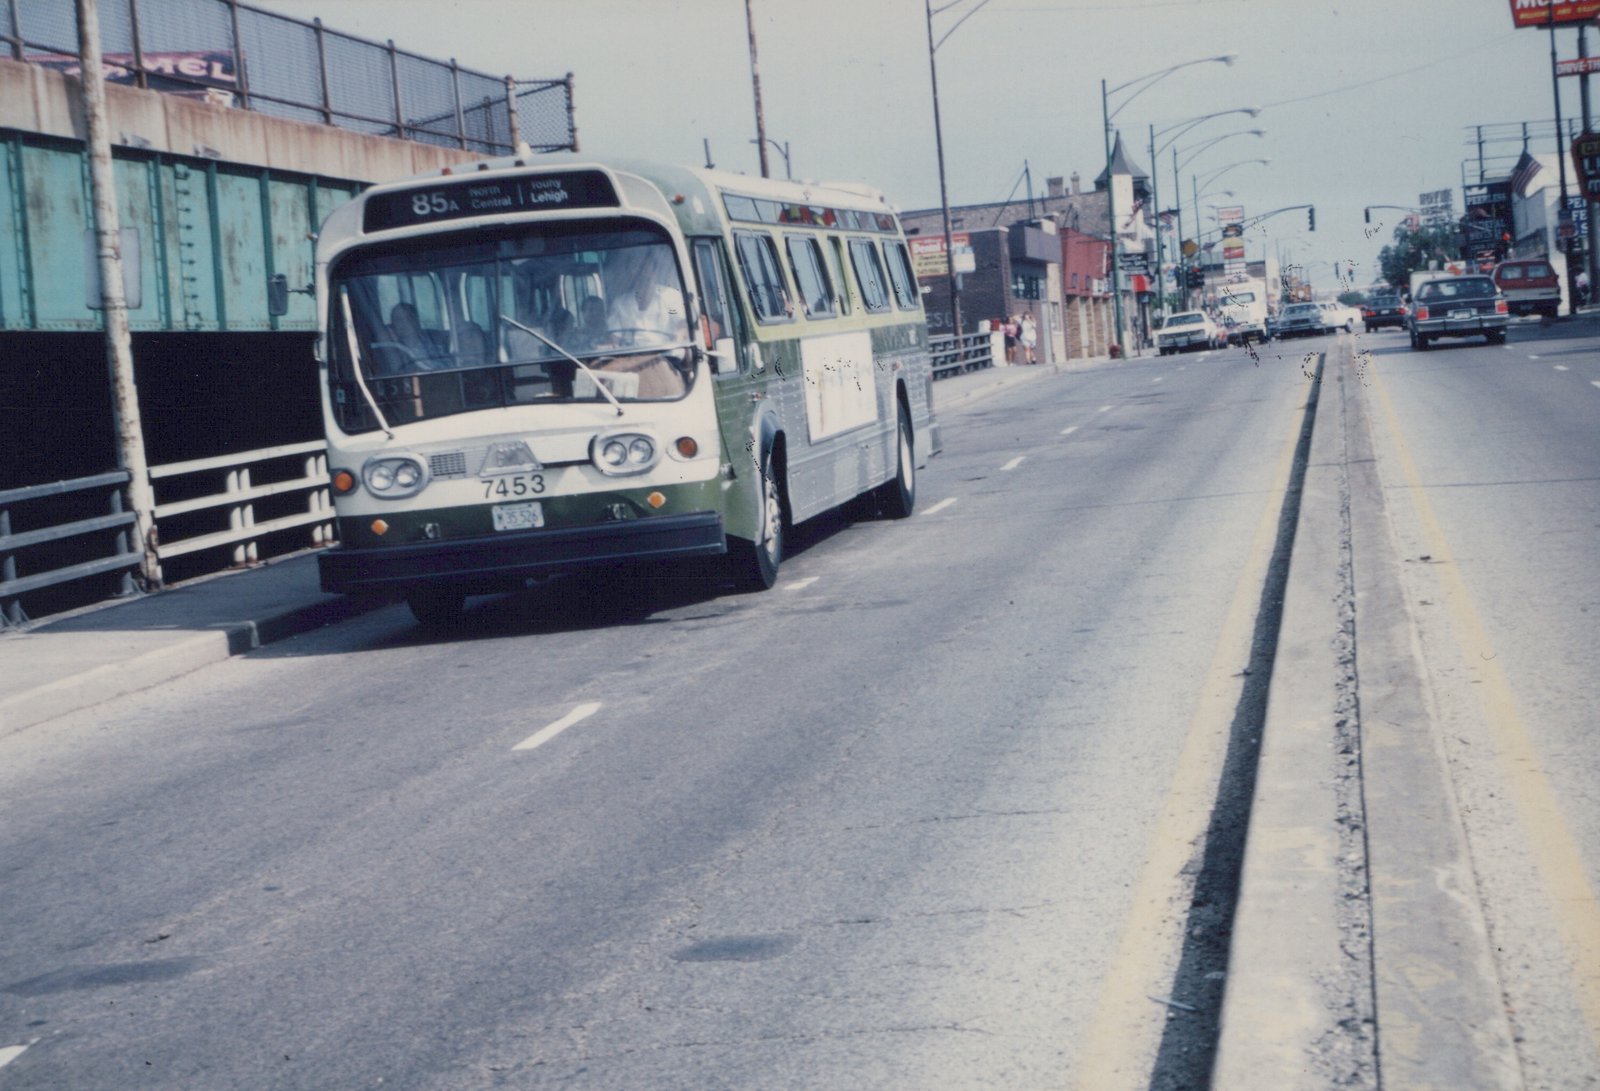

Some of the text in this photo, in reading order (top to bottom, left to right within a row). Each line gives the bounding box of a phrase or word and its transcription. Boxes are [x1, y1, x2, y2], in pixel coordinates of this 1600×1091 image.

[471, 194, 512, 209] Central
[530, 189, 568, 204] Lehigh
[481, 474, 546, 499] 7453
